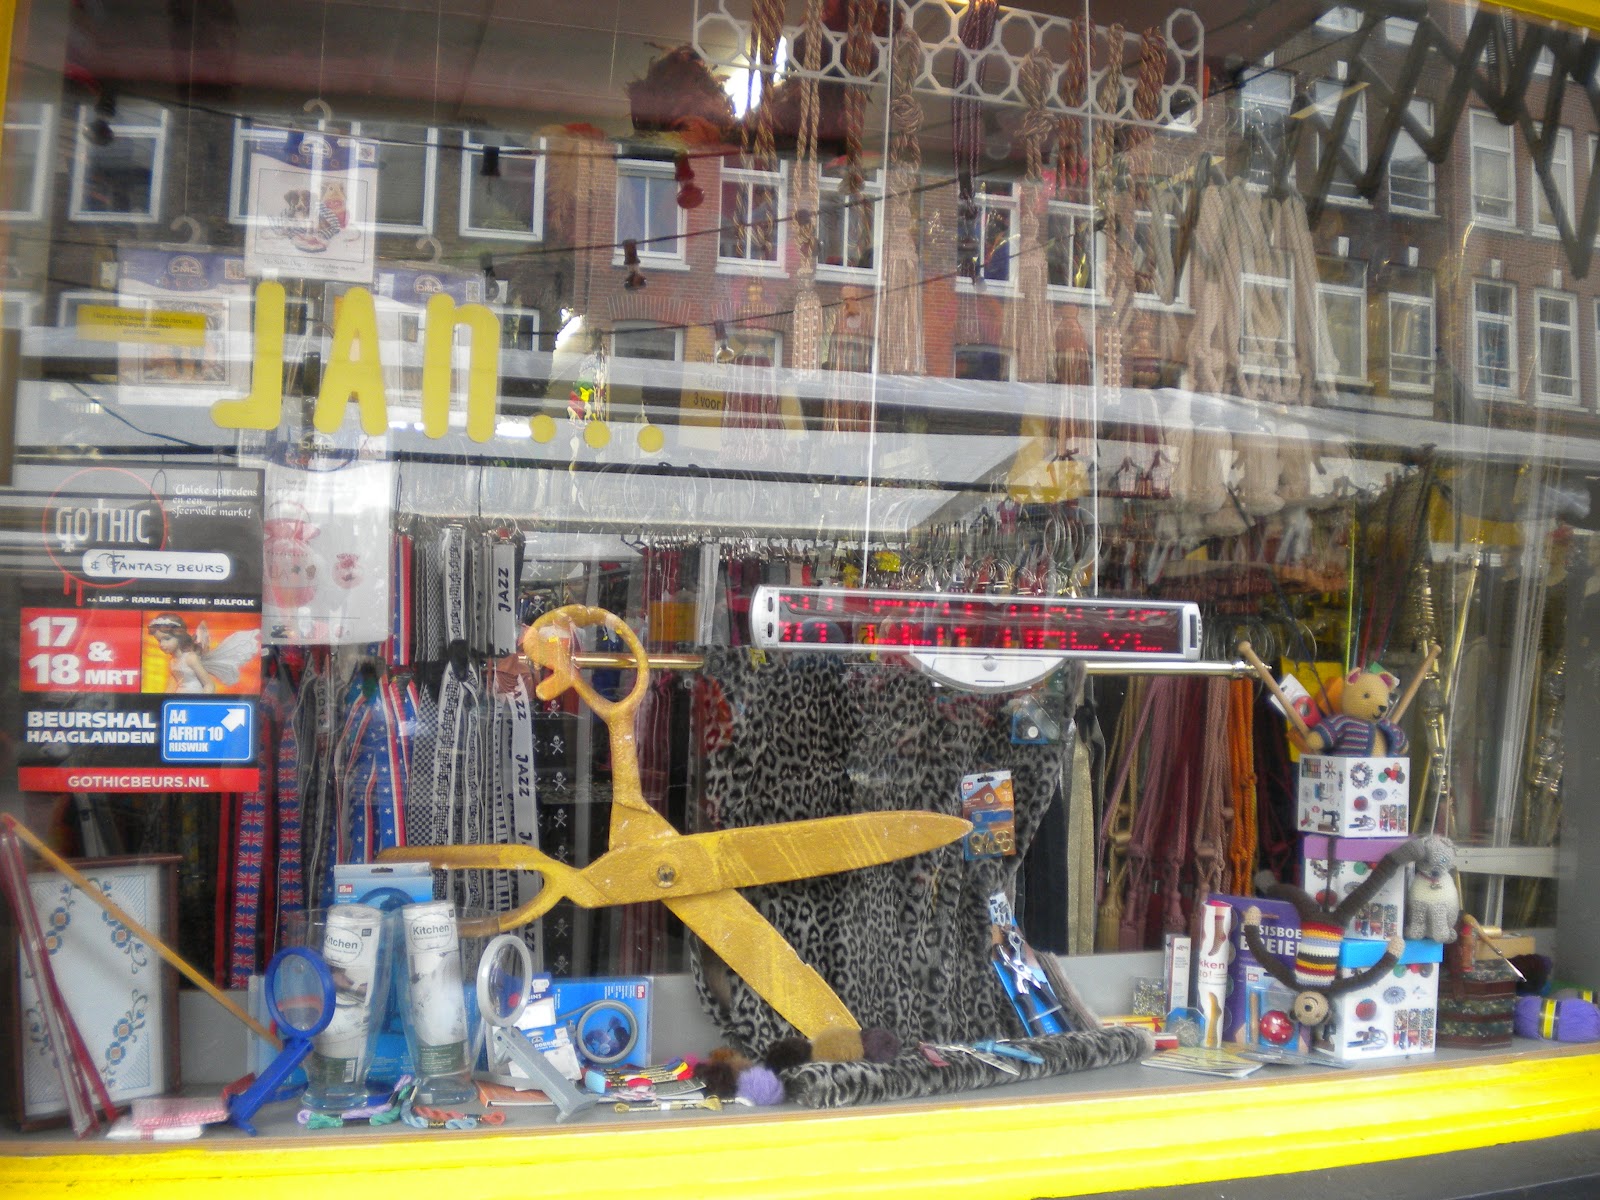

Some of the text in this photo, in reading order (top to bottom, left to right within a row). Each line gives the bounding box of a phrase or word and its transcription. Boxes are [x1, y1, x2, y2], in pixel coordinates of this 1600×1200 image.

[56, 498, 151, 553] GOTHIC
[498, 567, 511, 612] JAZZ
[99, 595, 123, 603] LARP
[132, 596, 171, 604] RAPALJE
[213, 598, 254, 606] BALFOLK
[29, 616, 77, 647] 17
[88, 641, 113, 662] &
[28, 654, 137, 685] 18 MRT
[27, 711, 156, 728] BEURSHAL
[169, 709, 187, 724] A4
[27, 730, 155, 744] HAAGLANDEN
[169, 726, 223, 741] AFRIT 10
[169, 743, 208, 752] RIJSWIJK
[68, 776, 209, 788] GOTHICBEURS.NL
[515, 754, 530, 797] JAZZ
[413, 924, 450, 936] Kitchen
[1240, 922, 1302, 940] SISBOE
